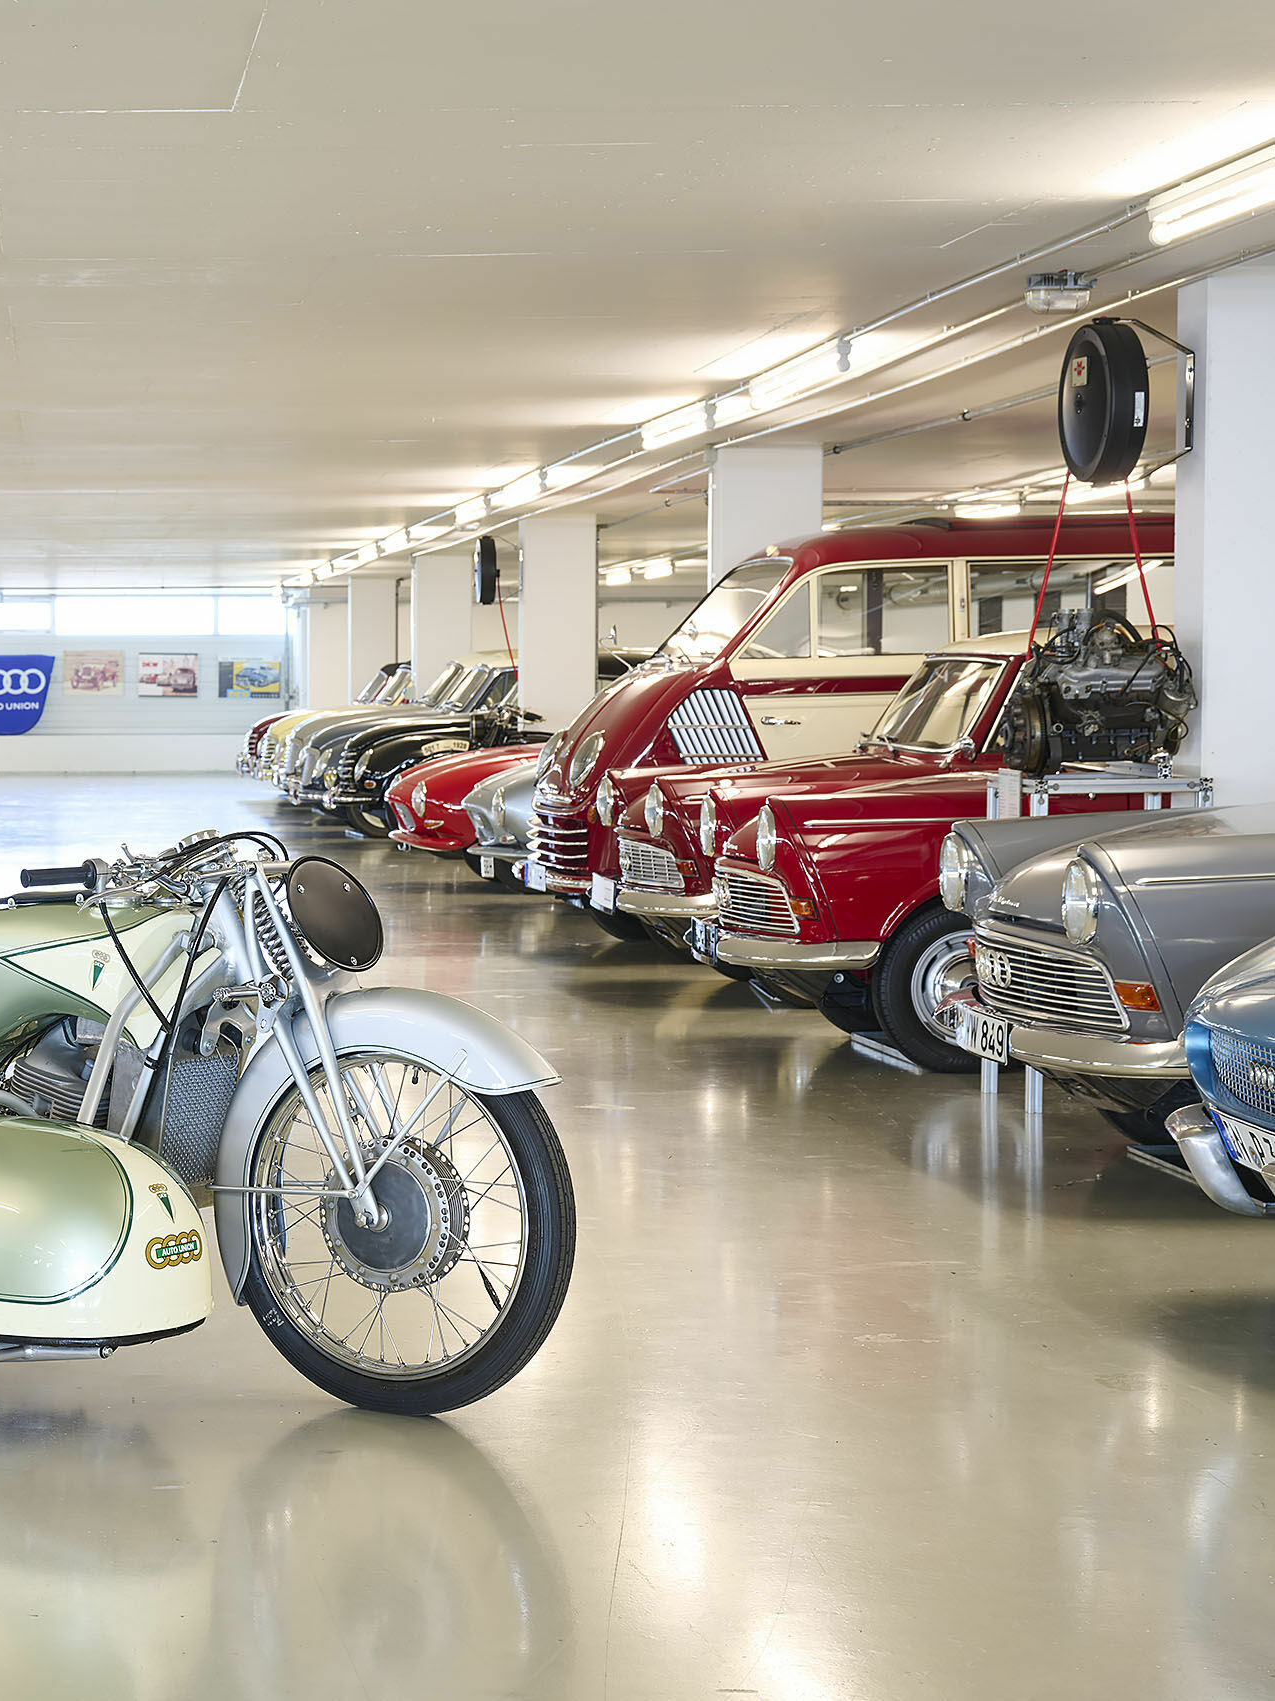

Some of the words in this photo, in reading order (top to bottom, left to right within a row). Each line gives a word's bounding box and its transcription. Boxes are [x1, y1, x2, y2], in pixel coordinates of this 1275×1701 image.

[5, 701, 39, 710] UNION
[980, 1019, 1004, 1058] 849
[162, 1247, 178, 1257] AUTO
[178, 1242, 195, 1253] UNION
